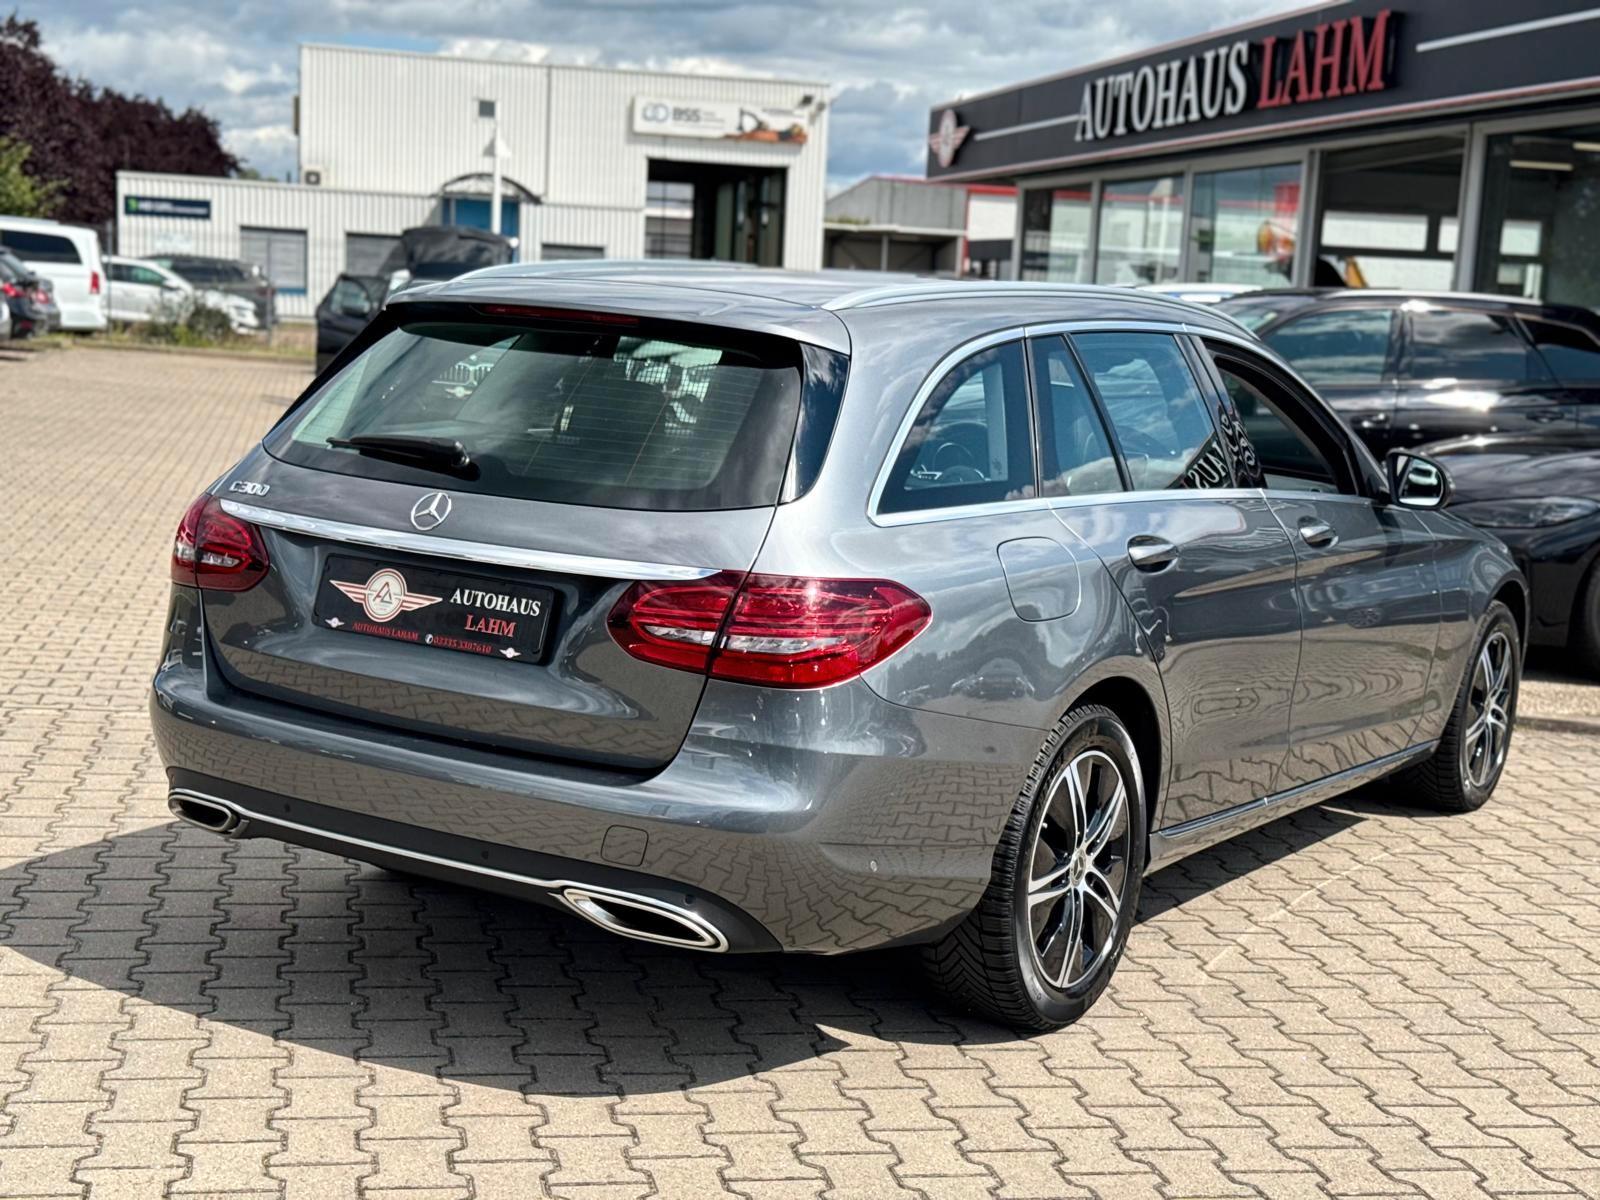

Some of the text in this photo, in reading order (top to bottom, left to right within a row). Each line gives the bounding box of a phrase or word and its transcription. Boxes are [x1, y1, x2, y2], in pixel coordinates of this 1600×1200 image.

[1074, 8, 1391, 143] AUTOHAUS LAHM
[229, 480, 270, 496] C300
[450, 588, 541, 617] AUTOHAUS
[464, 614, 516, 638] LAHM
